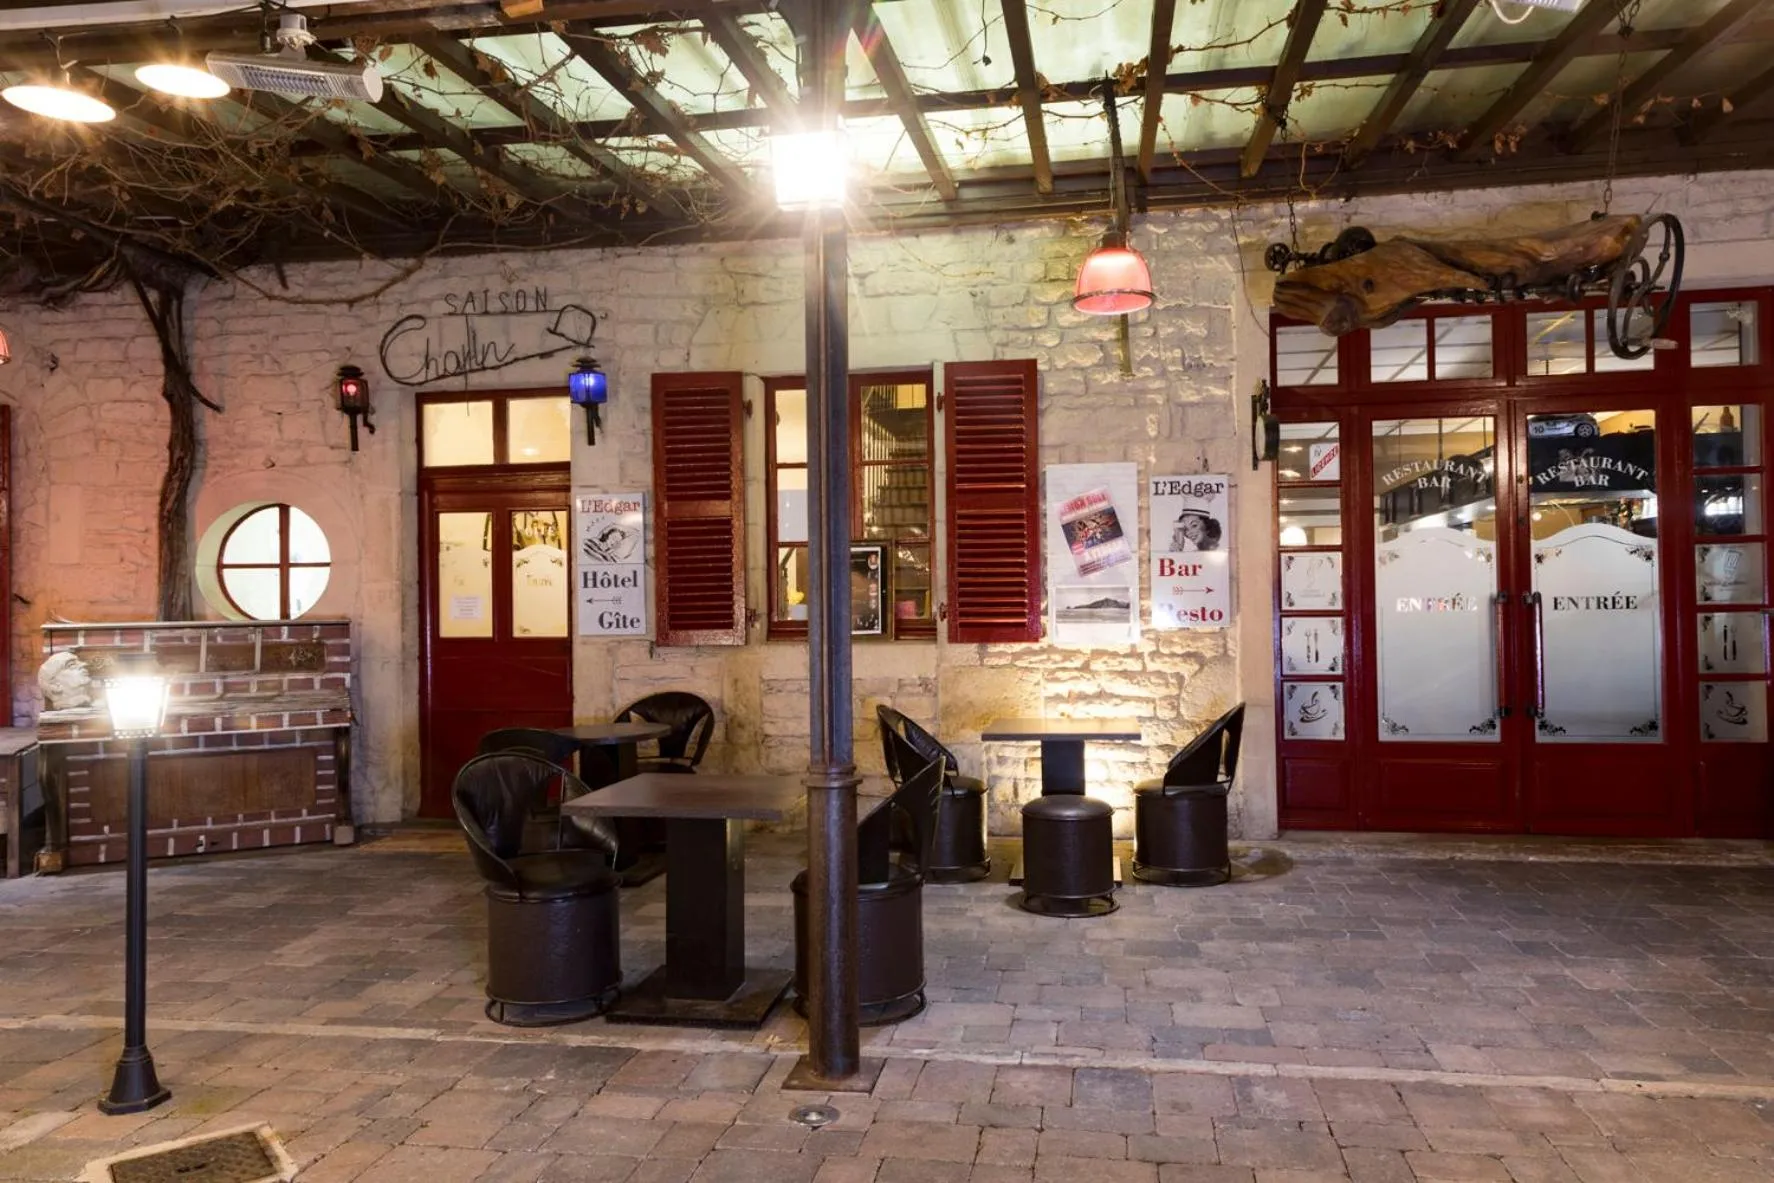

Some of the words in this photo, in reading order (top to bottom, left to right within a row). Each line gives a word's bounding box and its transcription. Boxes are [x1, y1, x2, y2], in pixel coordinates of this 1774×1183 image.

[444, 286, 548, 314] SAISON
[1381, 458, 1486, 487] RESTAURANT
[1536, 456, 1649, 486] RESTAURANT
[1574, 473, 1610, 488] BAR
[1152, 480, 1225, 498] L'Edgar
[1416, 475, 1452, 489] BAR
[580, 499, 641, 516] L'Edgar
[1158, 557, 1203, 577] Bar
[582, 570, 639, 589] Hôtel
[1552, 590, 1639, 611] ENTRÉE
[598, 610, 641, 630] Gîte
[1158, 602, 1224, 623] esto
